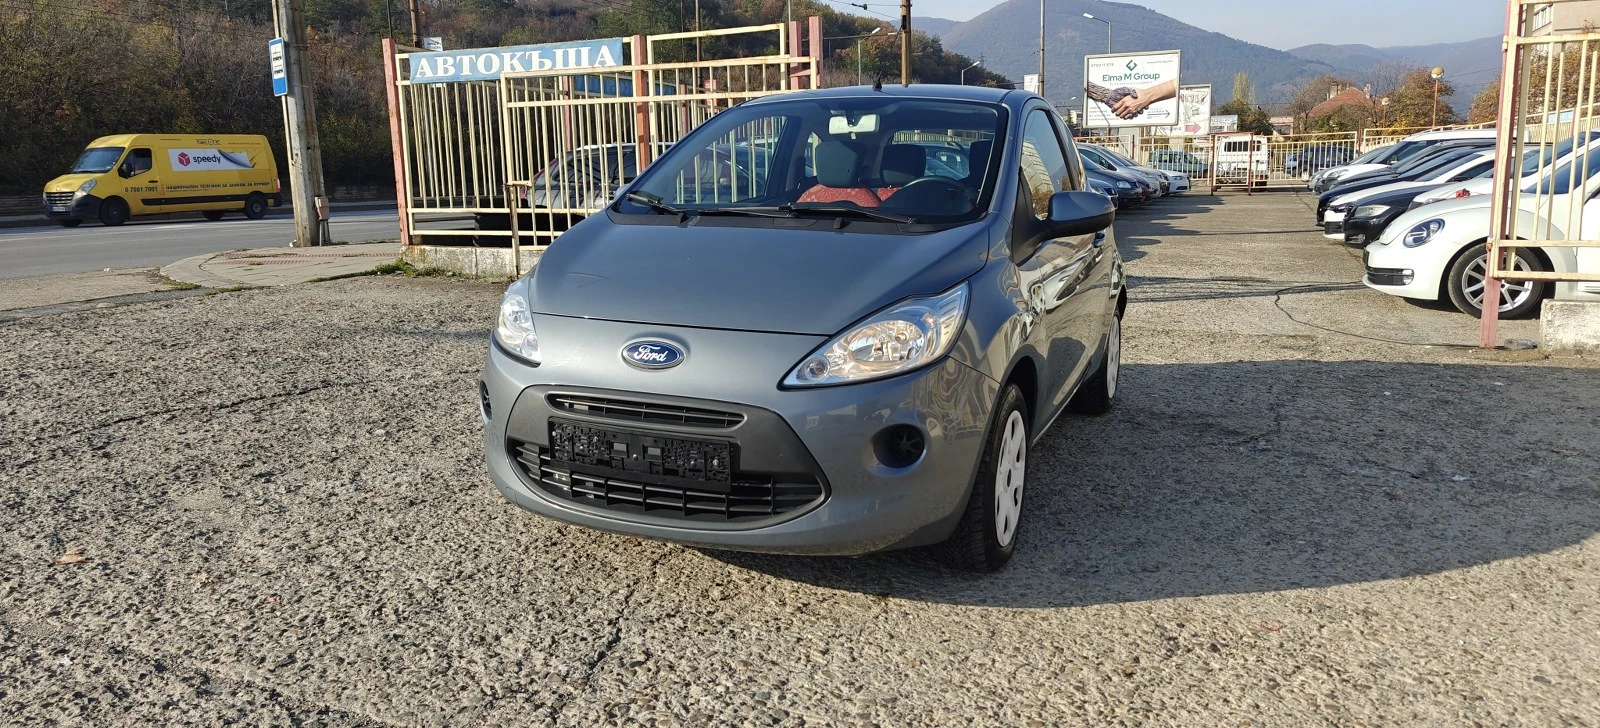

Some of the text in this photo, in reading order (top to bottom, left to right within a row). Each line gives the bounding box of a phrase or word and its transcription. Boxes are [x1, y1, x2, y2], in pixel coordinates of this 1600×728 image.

[1133, 72, 1160, 80] Group
[193, 154, 220, 164] speedy
[633, 344, 669, 361] Ford
